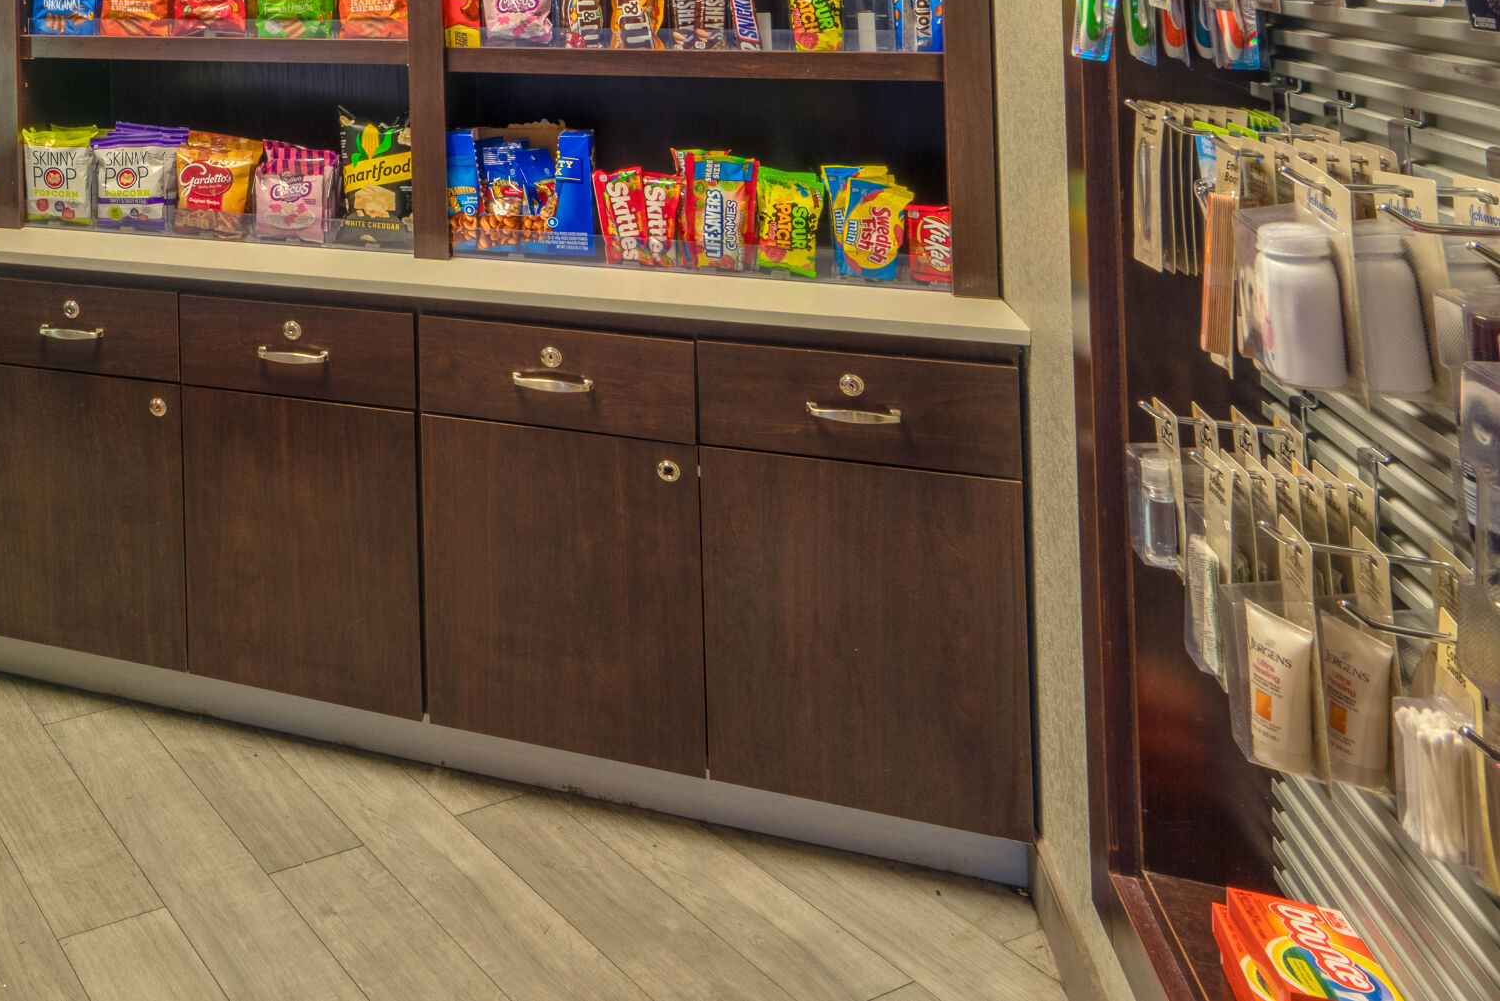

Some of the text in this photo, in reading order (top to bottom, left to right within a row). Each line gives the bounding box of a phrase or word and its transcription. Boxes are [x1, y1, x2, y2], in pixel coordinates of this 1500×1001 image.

[350, 4, 395, 12] CHEDDAR
[32, 149, 77, 166] SKINNY
[105, 149, 148, 167] SKINNY
[33, 166, 77, 189] POP
[104, 166, 149, 189] POP
[180, 163, 233, 198] Gardetto's
[447, 186, 477, 196] PLANTERS
[34, 189, 79, 198] POPCORN
[104, 189, 151, 197] POPCORN
[1306, 187, 1338, 221] Johnson's
[345, 219, 400, 231] WHITE CHEDDAR
[606, 181, 640, 261] Skittles
[645, 185, 668, 255] Skittle
[722, 200, 738, 250] GUMMIES
[776, 202, 792, 250] PATCH
[792, 206, 808, 250] SOUR
[834, 208, 843, 234] mini
[846, 220, 858, 245] mini
[857, 216, 877, 250] Fish
[869, 206, 892, 263] Swedish
[1250, 637, 1292, 669] JERGENS
[1325, 649, 1370, 683] JERGENS
[1446, 659, 1467, 688] Swabs
